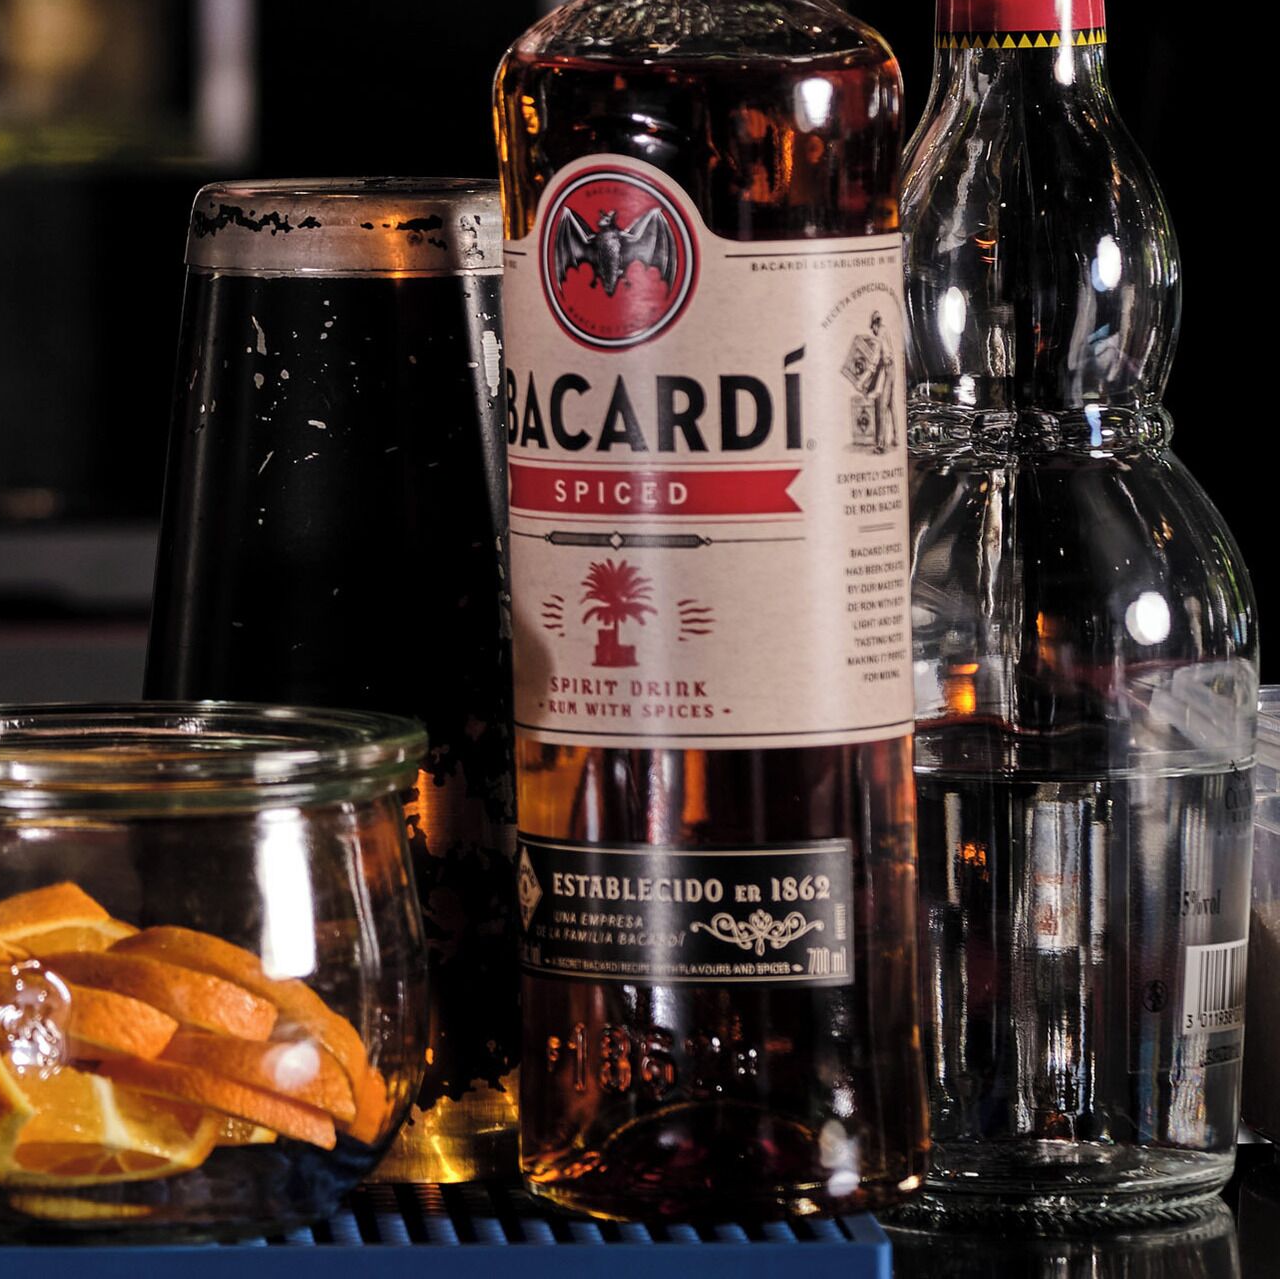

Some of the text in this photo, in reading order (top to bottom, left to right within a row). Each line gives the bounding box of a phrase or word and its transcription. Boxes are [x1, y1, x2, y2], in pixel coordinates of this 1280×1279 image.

[506, 346, 806, 452] BACARDÍ
[554, 479, 688, 505] SPICED
[550, 675, 708, 698] SPIRIT DRINK
[549, 699, 715, 719] RUM WITH SPICES
[552, 872, 724, 904] ESTABLECIDO
[771, 874, 831, 903] 1862
[554, 911, 644, 929] UNA EMPRESA
[563, 927, 614, 945] FAMILIA
[734, 962, 755, 975] AND
